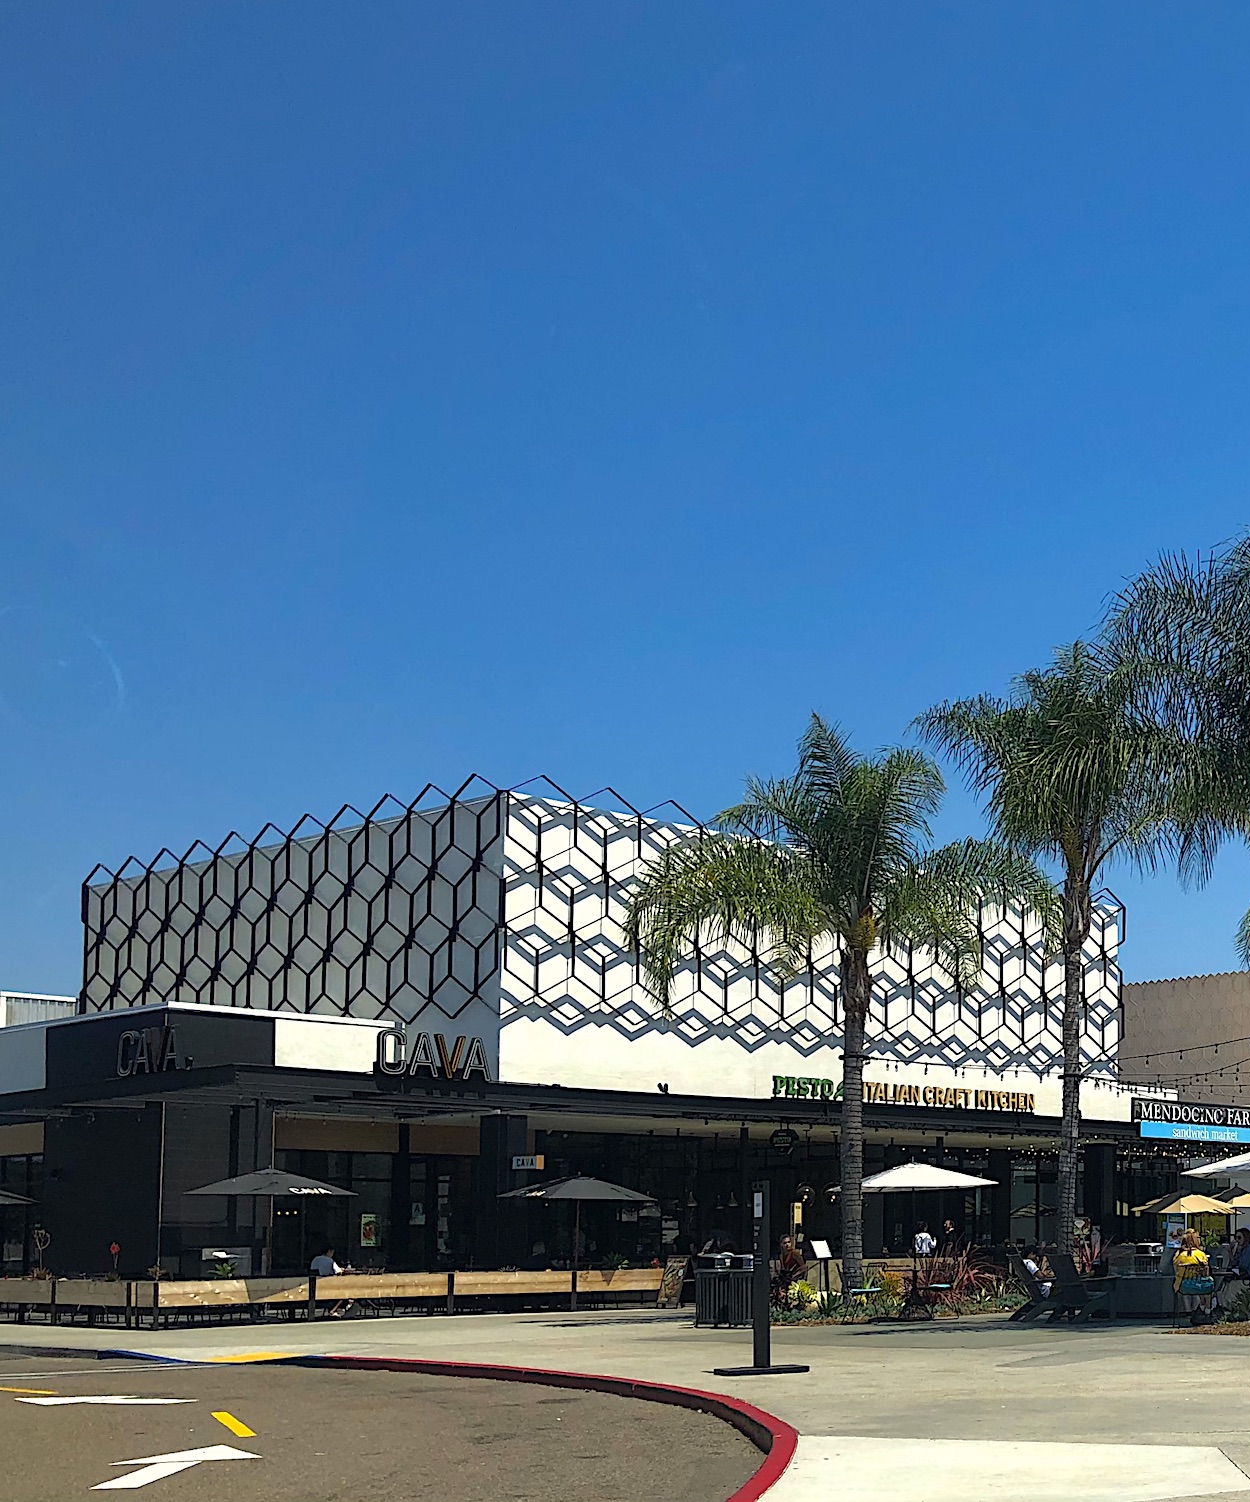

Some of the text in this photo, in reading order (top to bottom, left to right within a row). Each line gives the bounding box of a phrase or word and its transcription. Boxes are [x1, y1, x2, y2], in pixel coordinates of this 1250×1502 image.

[117, 1024, 181, 1077] CAVA
[378, 1028, 491, 1082] CAVA
[772, 1075, 1036, 1111] PESTO ITALIAN CRAFT KITCHEN
[1140, 1101, 1224, 1125] MENDOCINO
[1172, 1125, 1239, 1141] sandwich market
[516, 1158, 535, 1167] CAVA
